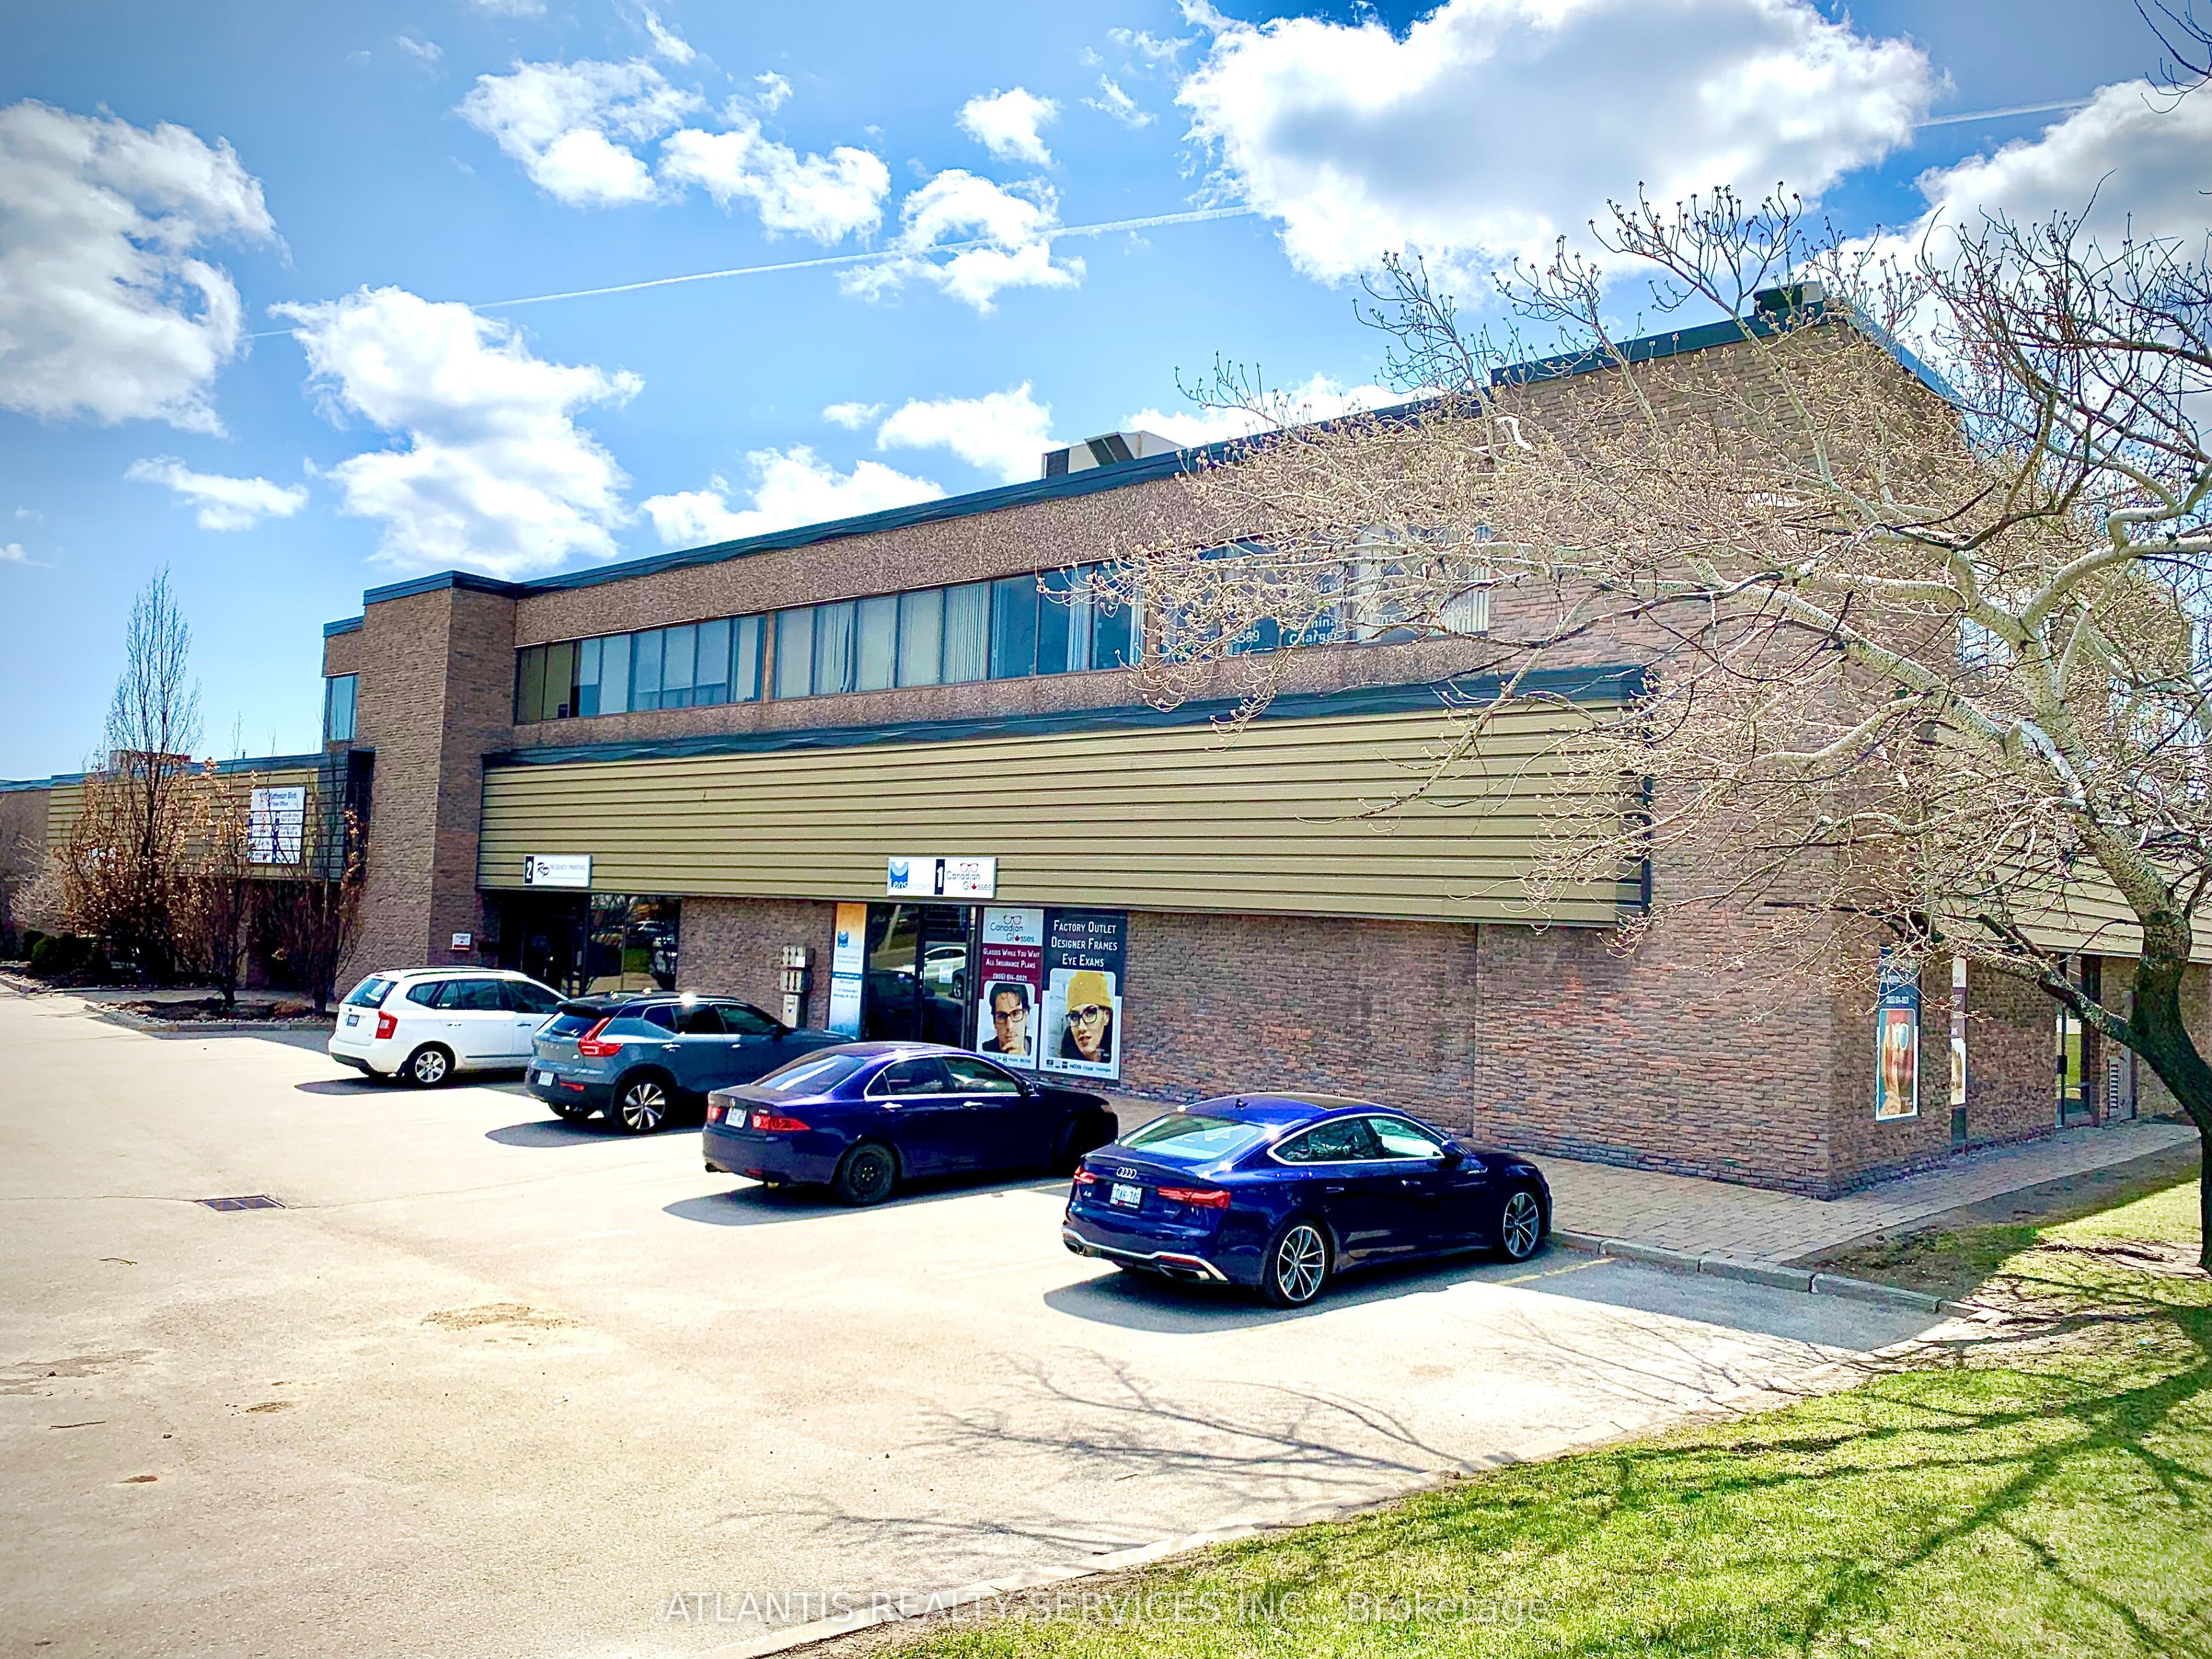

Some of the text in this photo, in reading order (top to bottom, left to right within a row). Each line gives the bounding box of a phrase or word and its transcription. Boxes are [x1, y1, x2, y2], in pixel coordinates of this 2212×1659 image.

[1289, 630, 1339, 645] Carge
[527, 861, 533, 878] 2
[946, 870, 980, 881] Canadian
[937, 866, 944, 888] 1
[889, 878, 908, 890] Lens
[963, 881, 992, 891] Glsses
[990, 922, 1023, 932] Canadian
[1054, 919, 1117, 934] FACTORY OUTLET
[1006, 933, 1035, 942] Glsses
[1051, 936, 1118, 951] DESIGNER FRAMES
[986, 958, 1036, 968] ALL INSURANCE PLANS
[1062, 953, 1105, 967] EYE EXAMS
